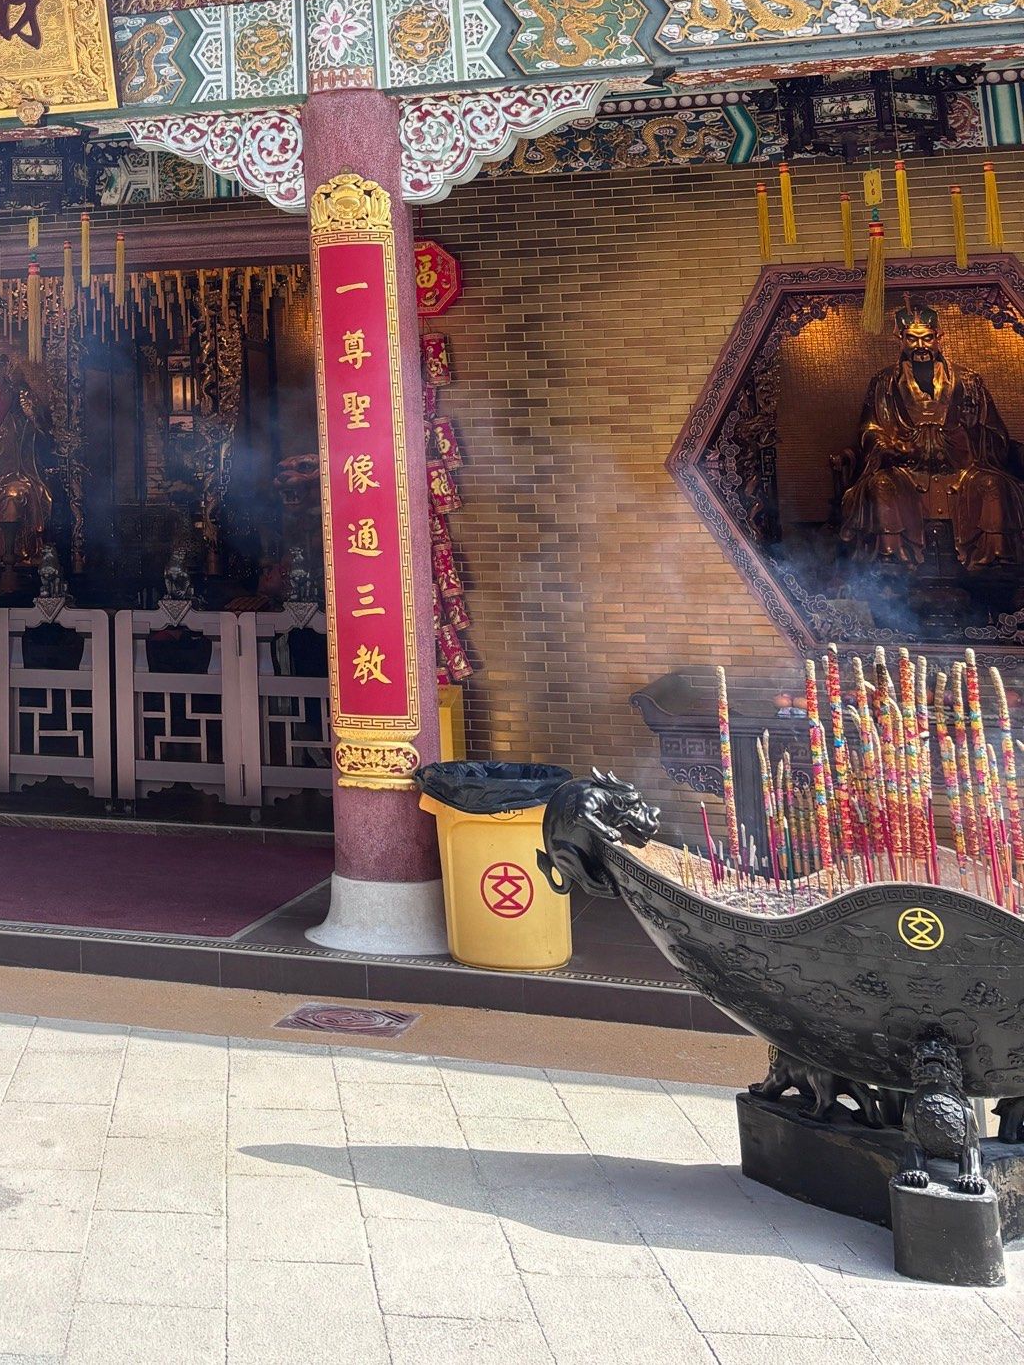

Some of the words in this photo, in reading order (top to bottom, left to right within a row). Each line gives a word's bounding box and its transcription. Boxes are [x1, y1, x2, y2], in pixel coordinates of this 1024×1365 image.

[335, 281, 393, 686] 一尊聖像通三教
